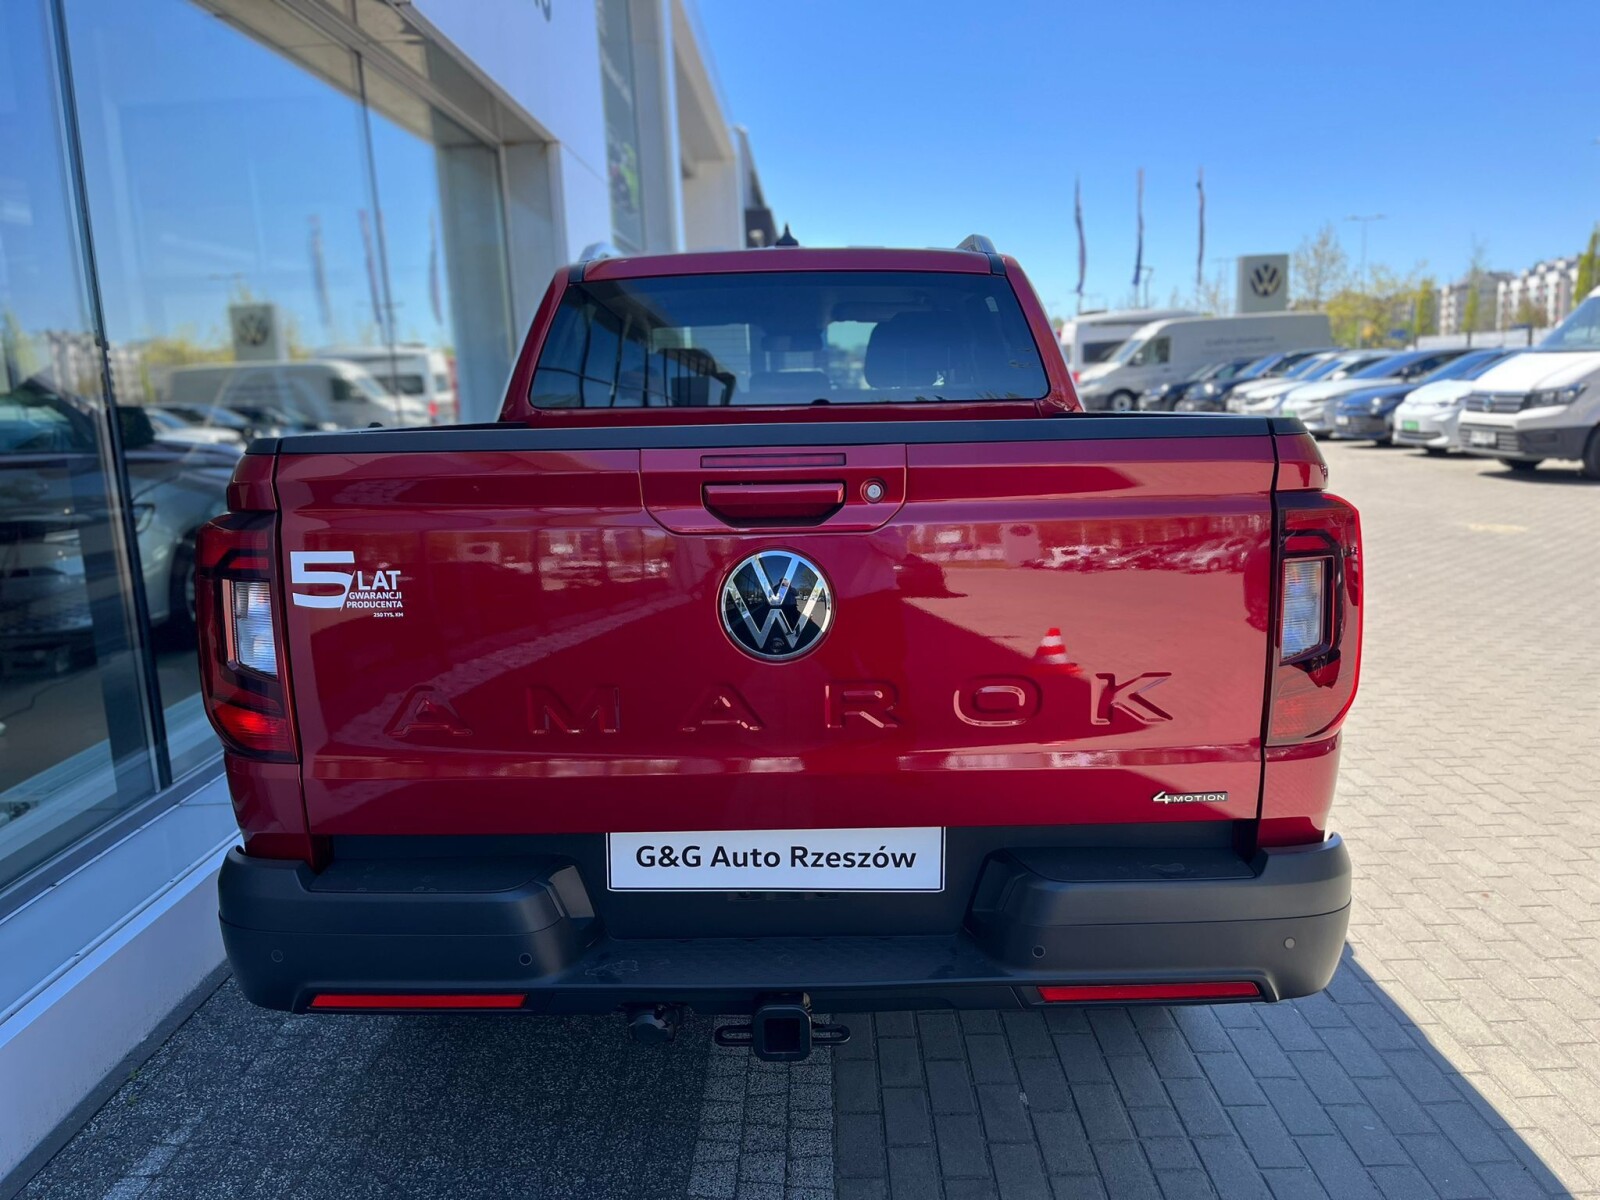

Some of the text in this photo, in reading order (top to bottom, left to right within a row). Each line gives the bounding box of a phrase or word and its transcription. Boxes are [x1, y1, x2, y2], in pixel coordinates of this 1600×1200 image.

[289, 550, 402, 609] 5 LAT
[346, 600, 403, 609] PRODUCENTA
[348, 591, 402, 600] GWARANCJI
[386, 672, 1174, 737] AMAROK
[1152, 790, 1226, 804] 4MOTION
[635, 844, 918, 869] G&G Auto Rzeszów
